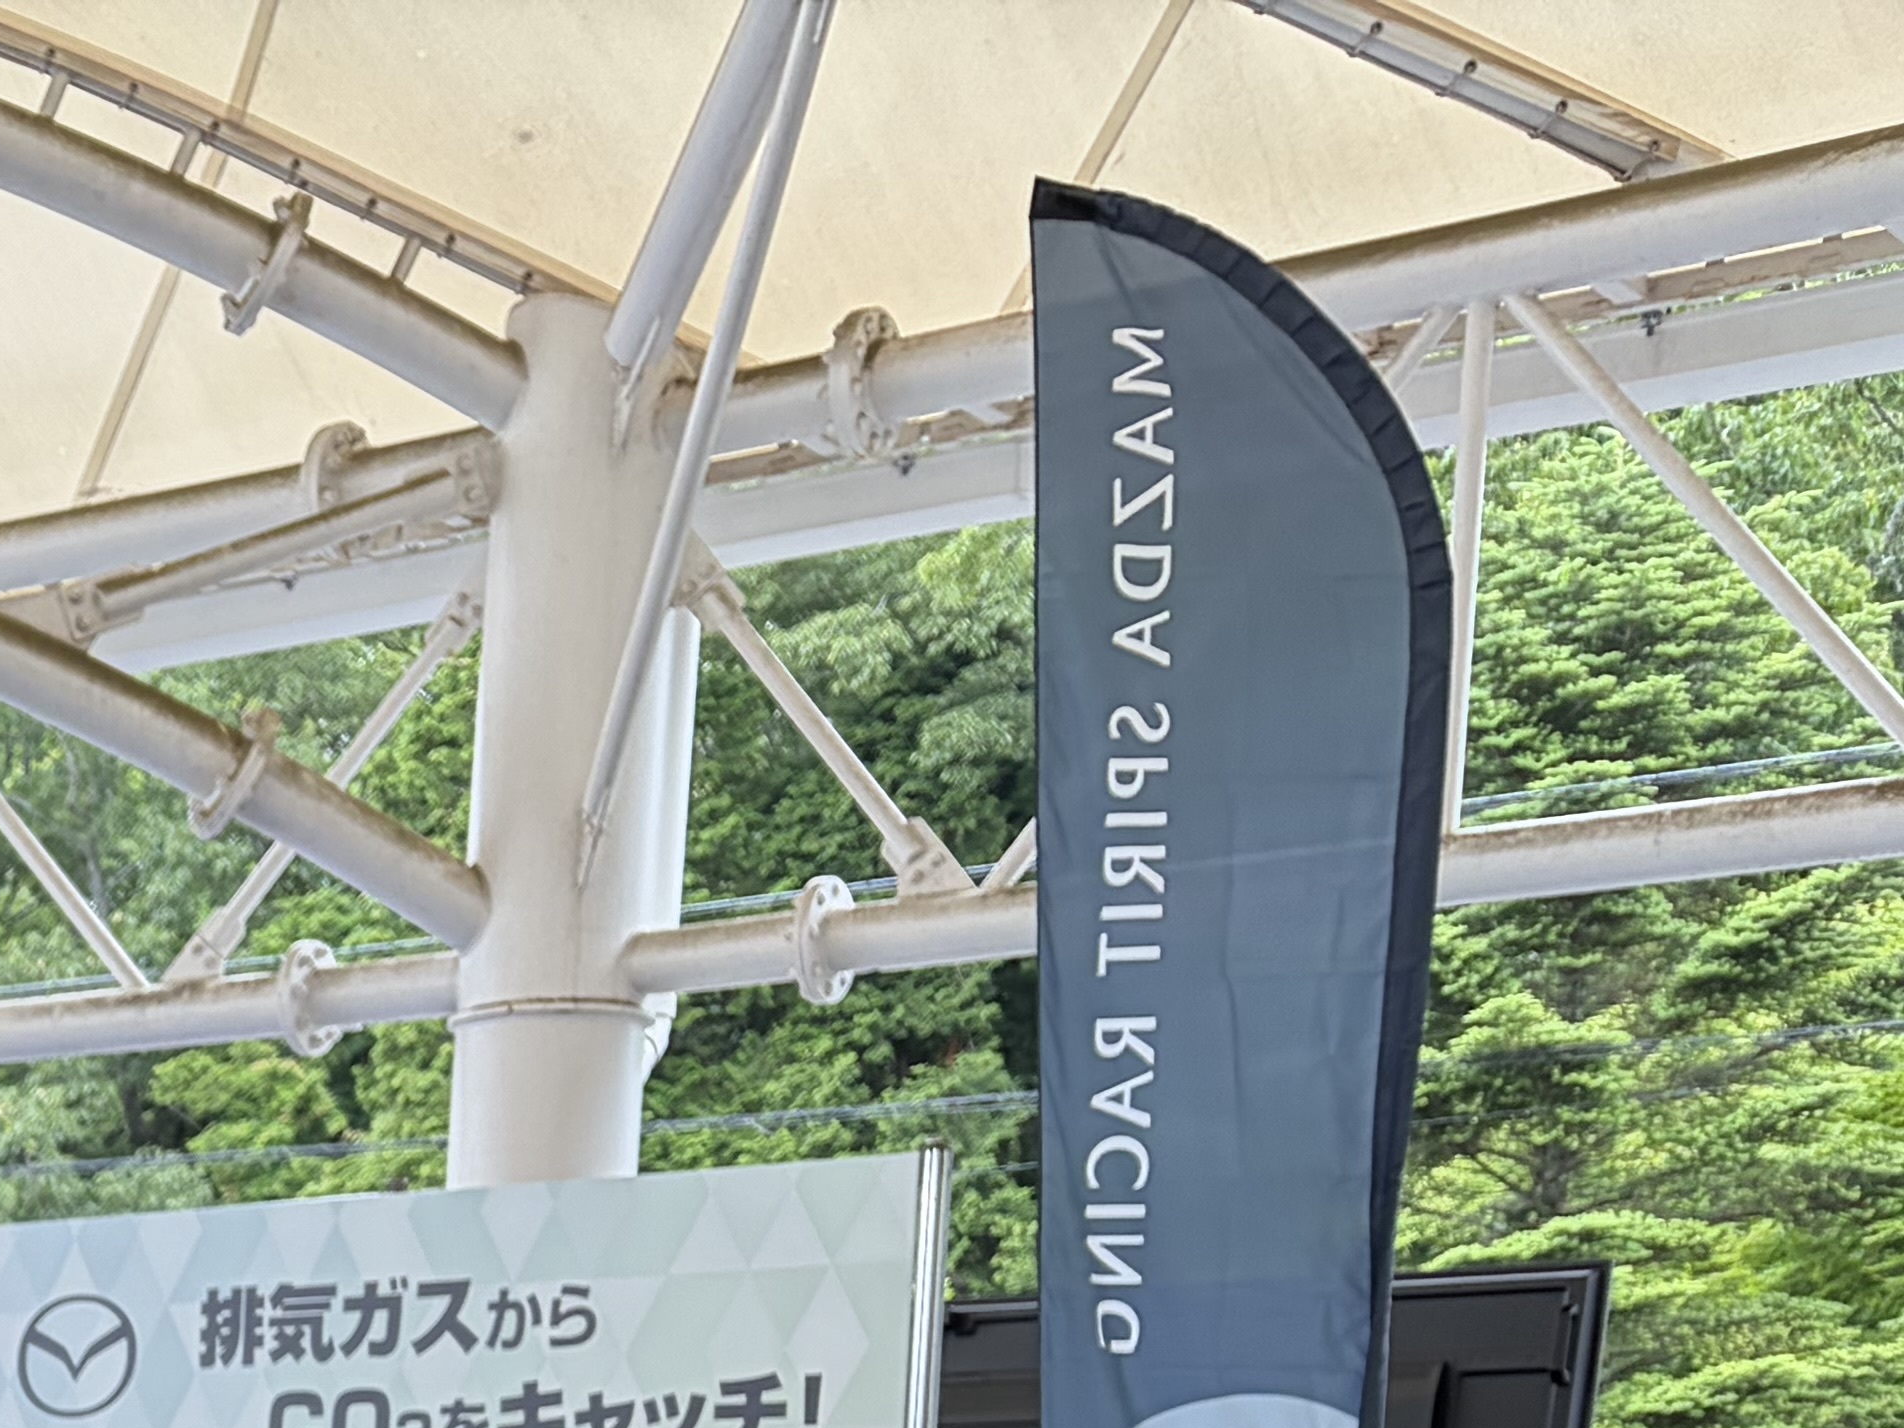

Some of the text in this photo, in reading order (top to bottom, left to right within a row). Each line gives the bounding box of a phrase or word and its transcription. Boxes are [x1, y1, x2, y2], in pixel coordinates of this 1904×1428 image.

[197, 1275, 597, 1368] 排気ガスから
